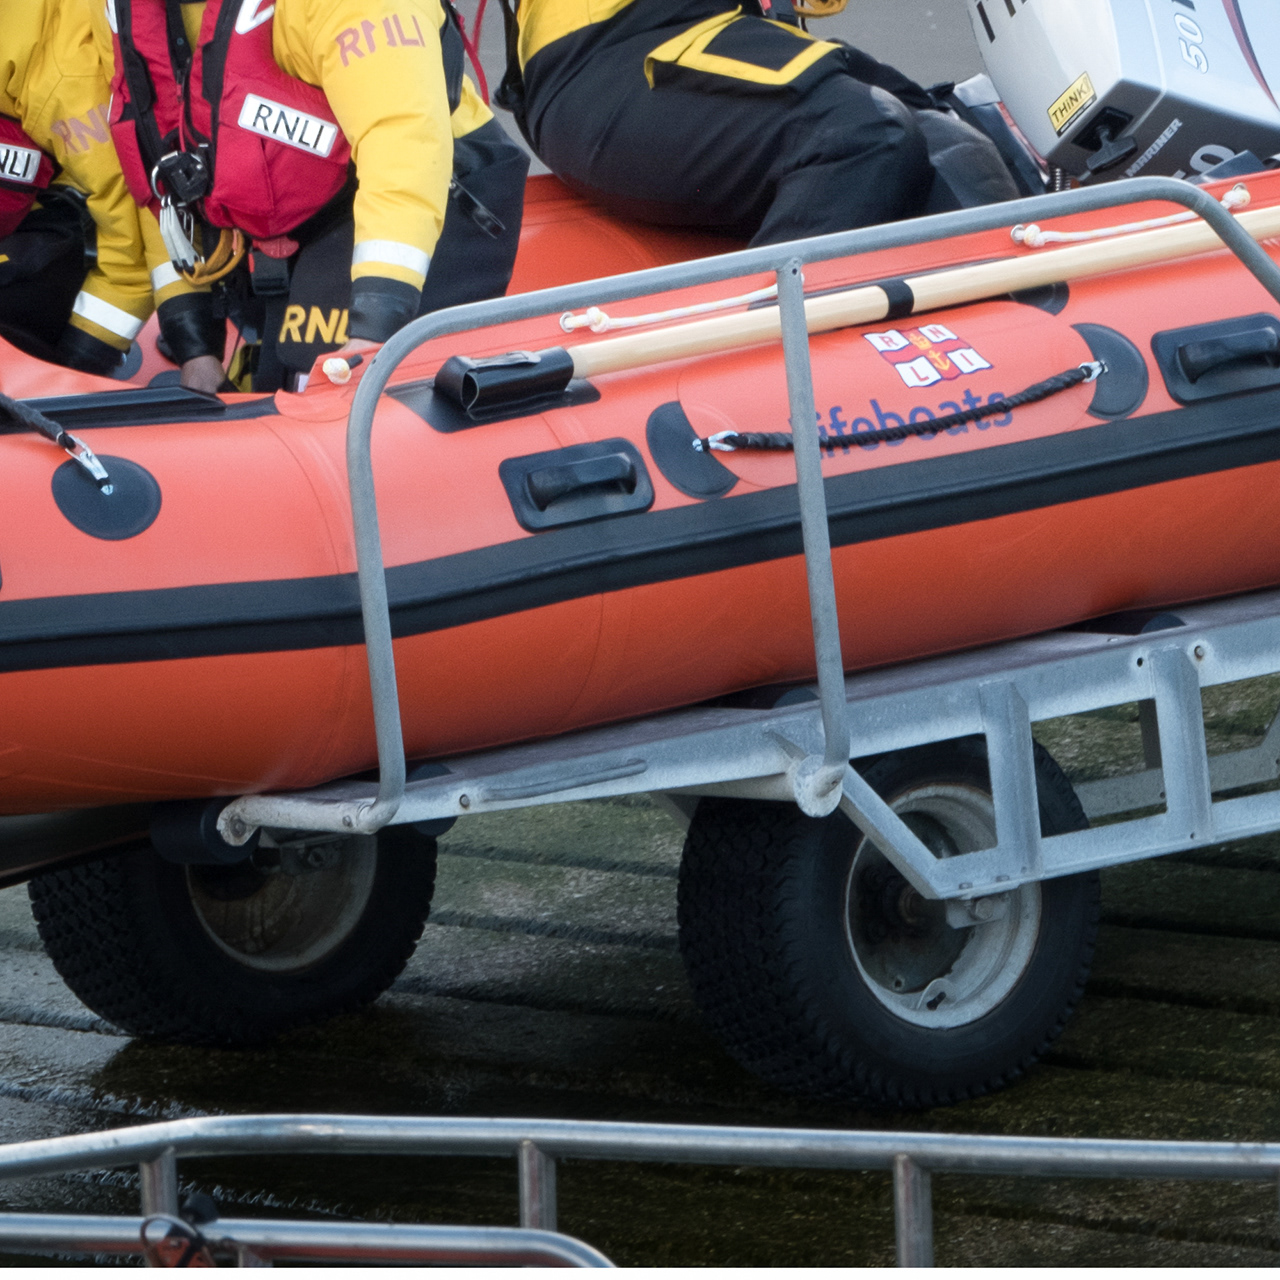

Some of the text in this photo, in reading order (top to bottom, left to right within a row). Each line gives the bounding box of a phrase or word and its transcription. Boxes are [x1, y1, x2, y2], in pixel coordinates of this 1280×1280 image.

[1173, 11, 1210, 75] 50
[251, 102, 331, 152] RNLI
[1123, 117, 1184, 178] MARINER
[790, 389, 1014, 461] ifeboats
